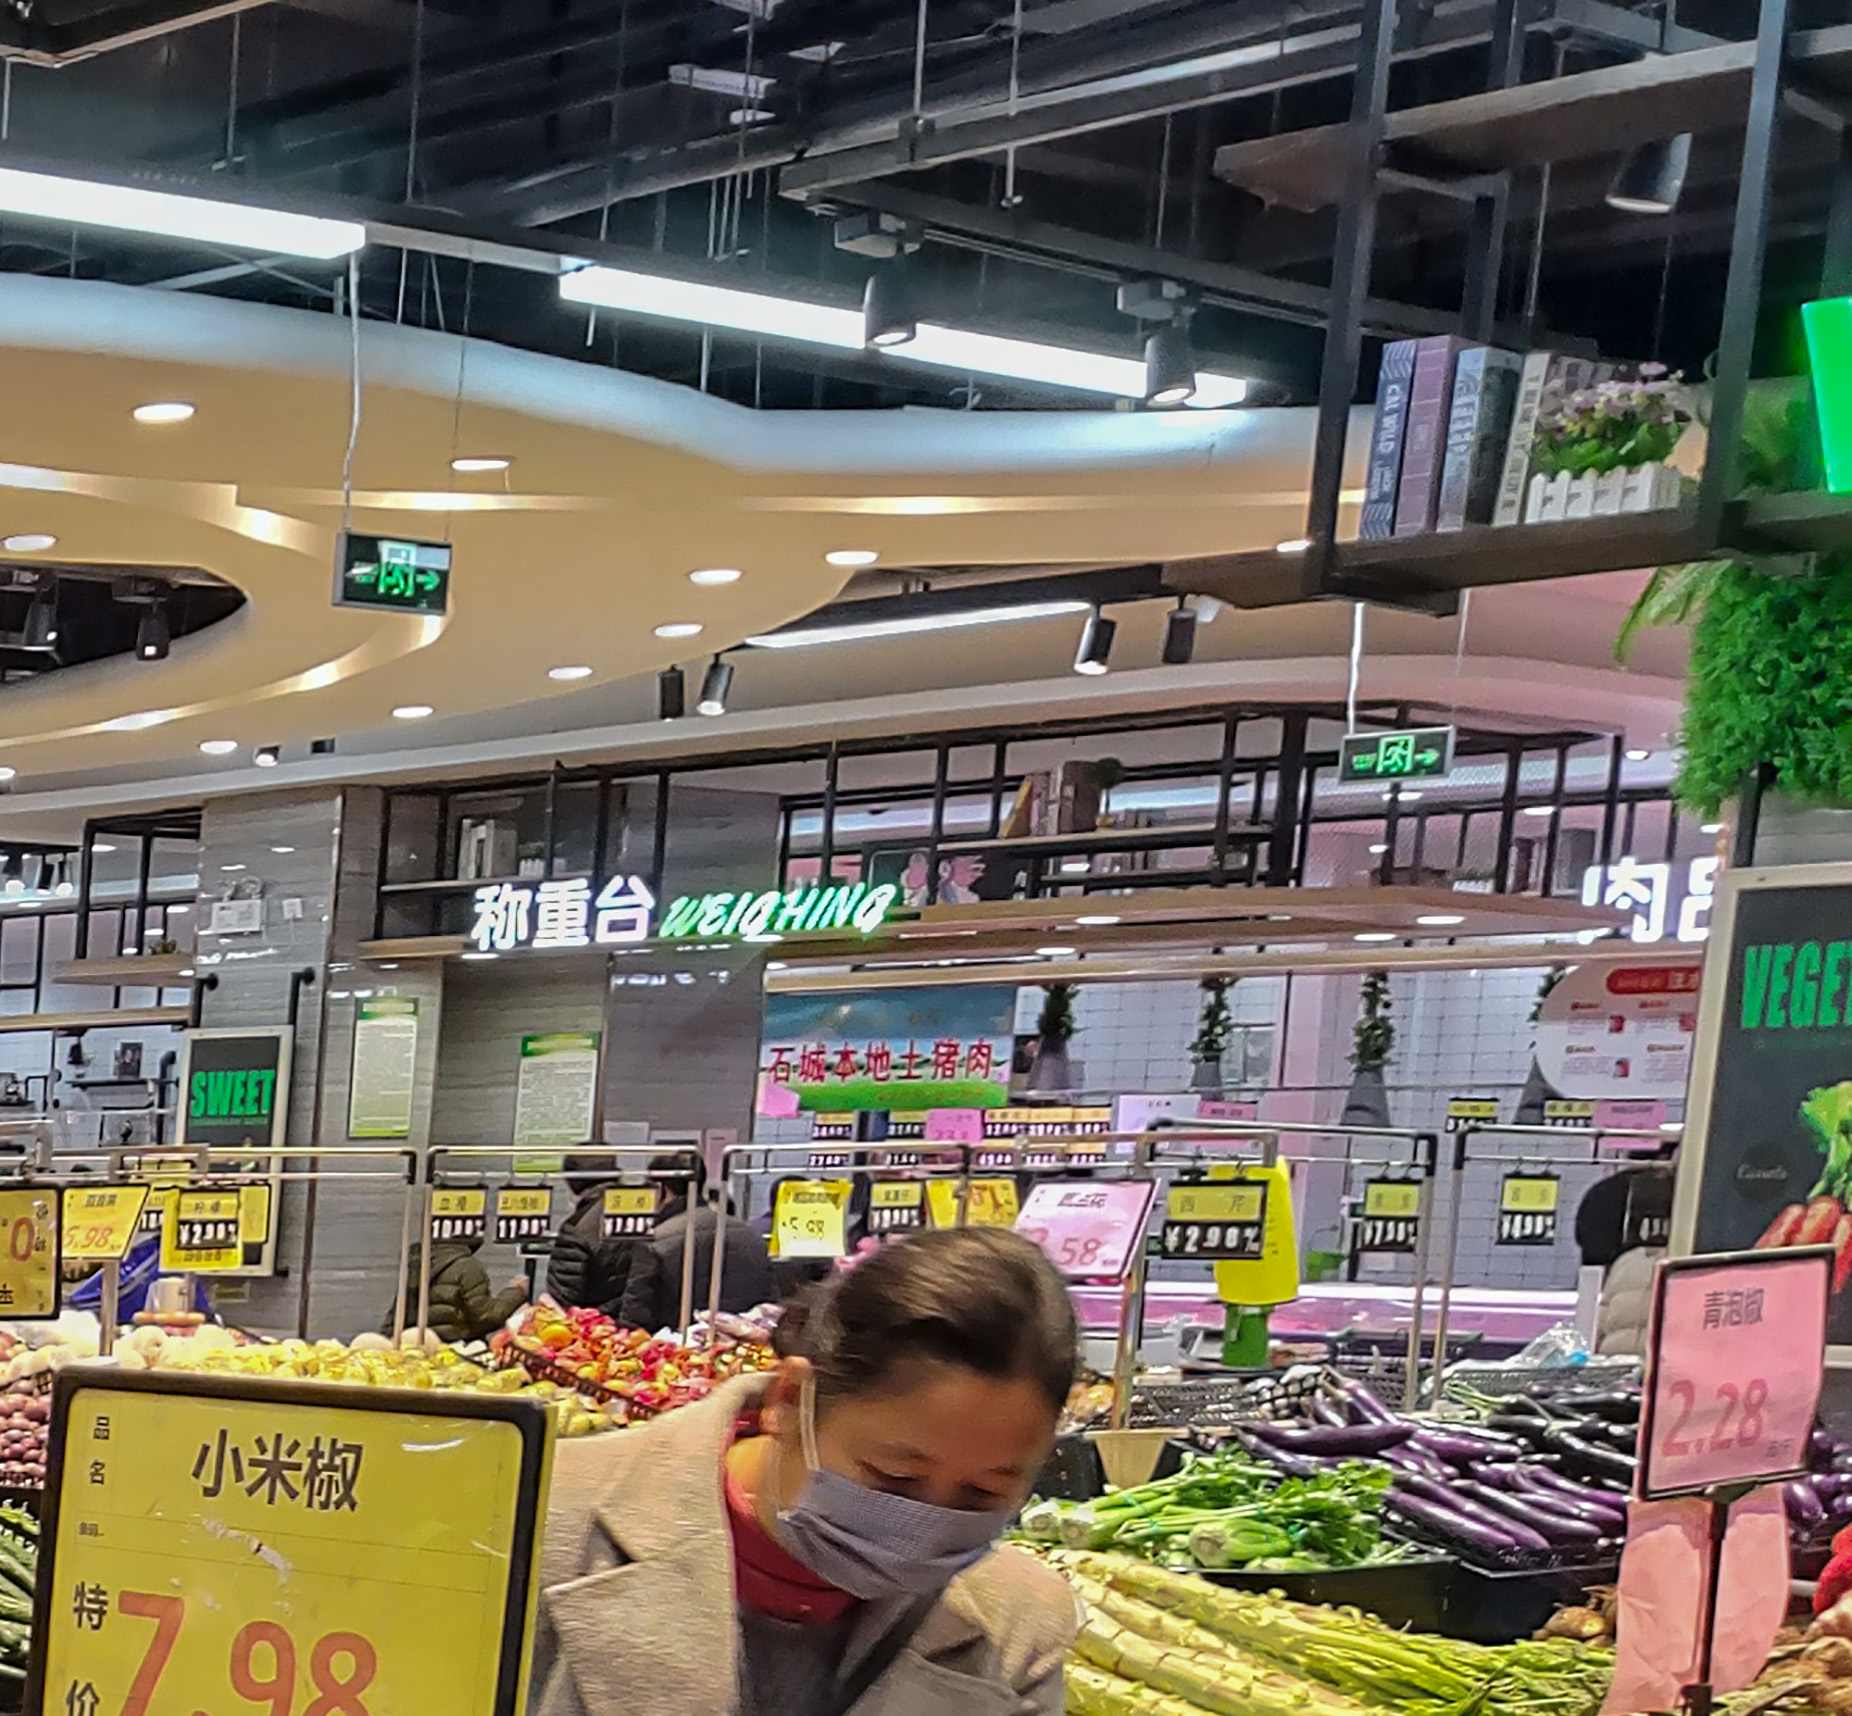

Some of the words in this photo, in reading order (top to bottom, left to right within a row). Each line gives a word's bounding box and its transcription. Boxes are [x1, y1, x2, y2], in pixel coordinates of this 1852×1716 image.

[471, 875, 656, 950] 称重台
[1741, 942, 1852, 1030] VEGE
[191, 1069, 275, 1117] SWEET
[767, 1037, 993, 1083] 石城本地土猪肉
[1662, 1378, 1768, 1456] 2.28
[192, 1428, 364, 1513] 小米椒
